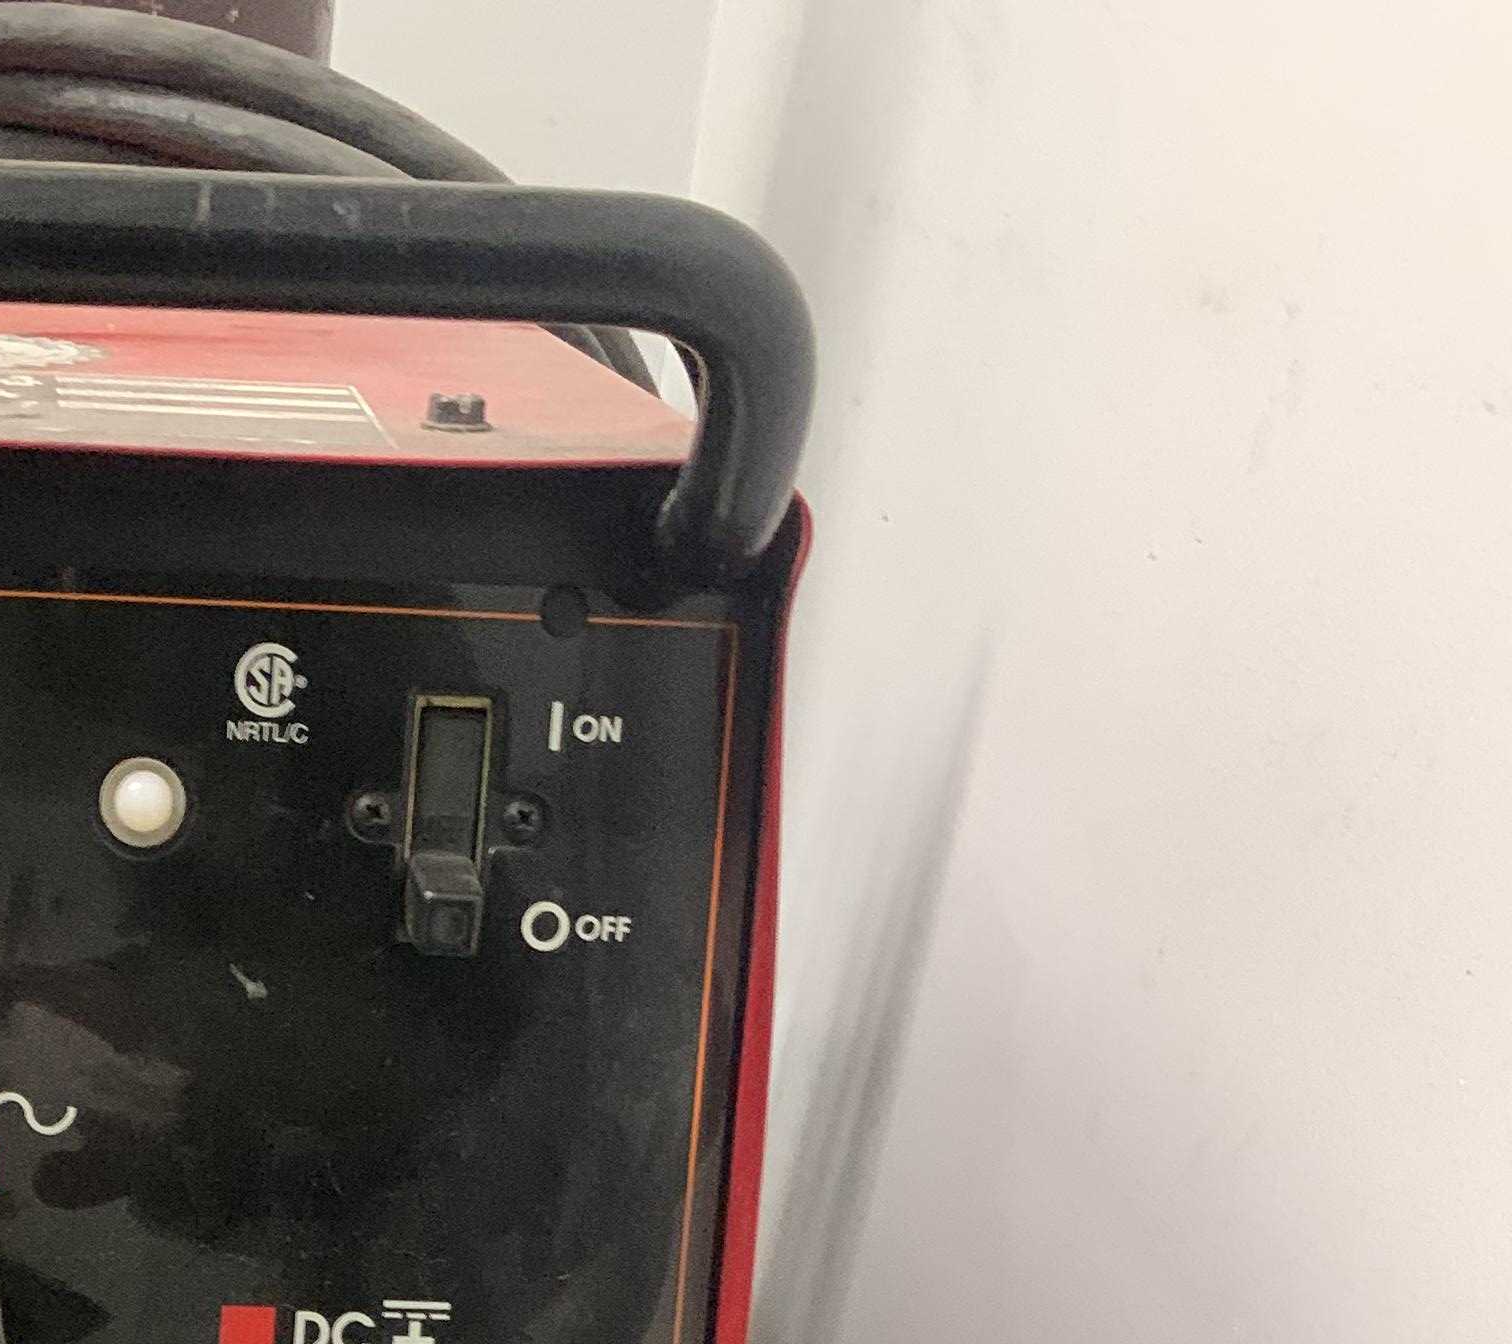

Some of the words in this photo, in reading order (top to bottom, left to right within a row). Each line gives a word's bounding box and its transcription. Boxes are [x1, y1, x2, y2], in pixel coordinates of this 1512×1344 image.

[227, 720, 308, 744] NRTL/C
[573, 715, 622, 742] ON
[575, 915, 631, 942] OFF
